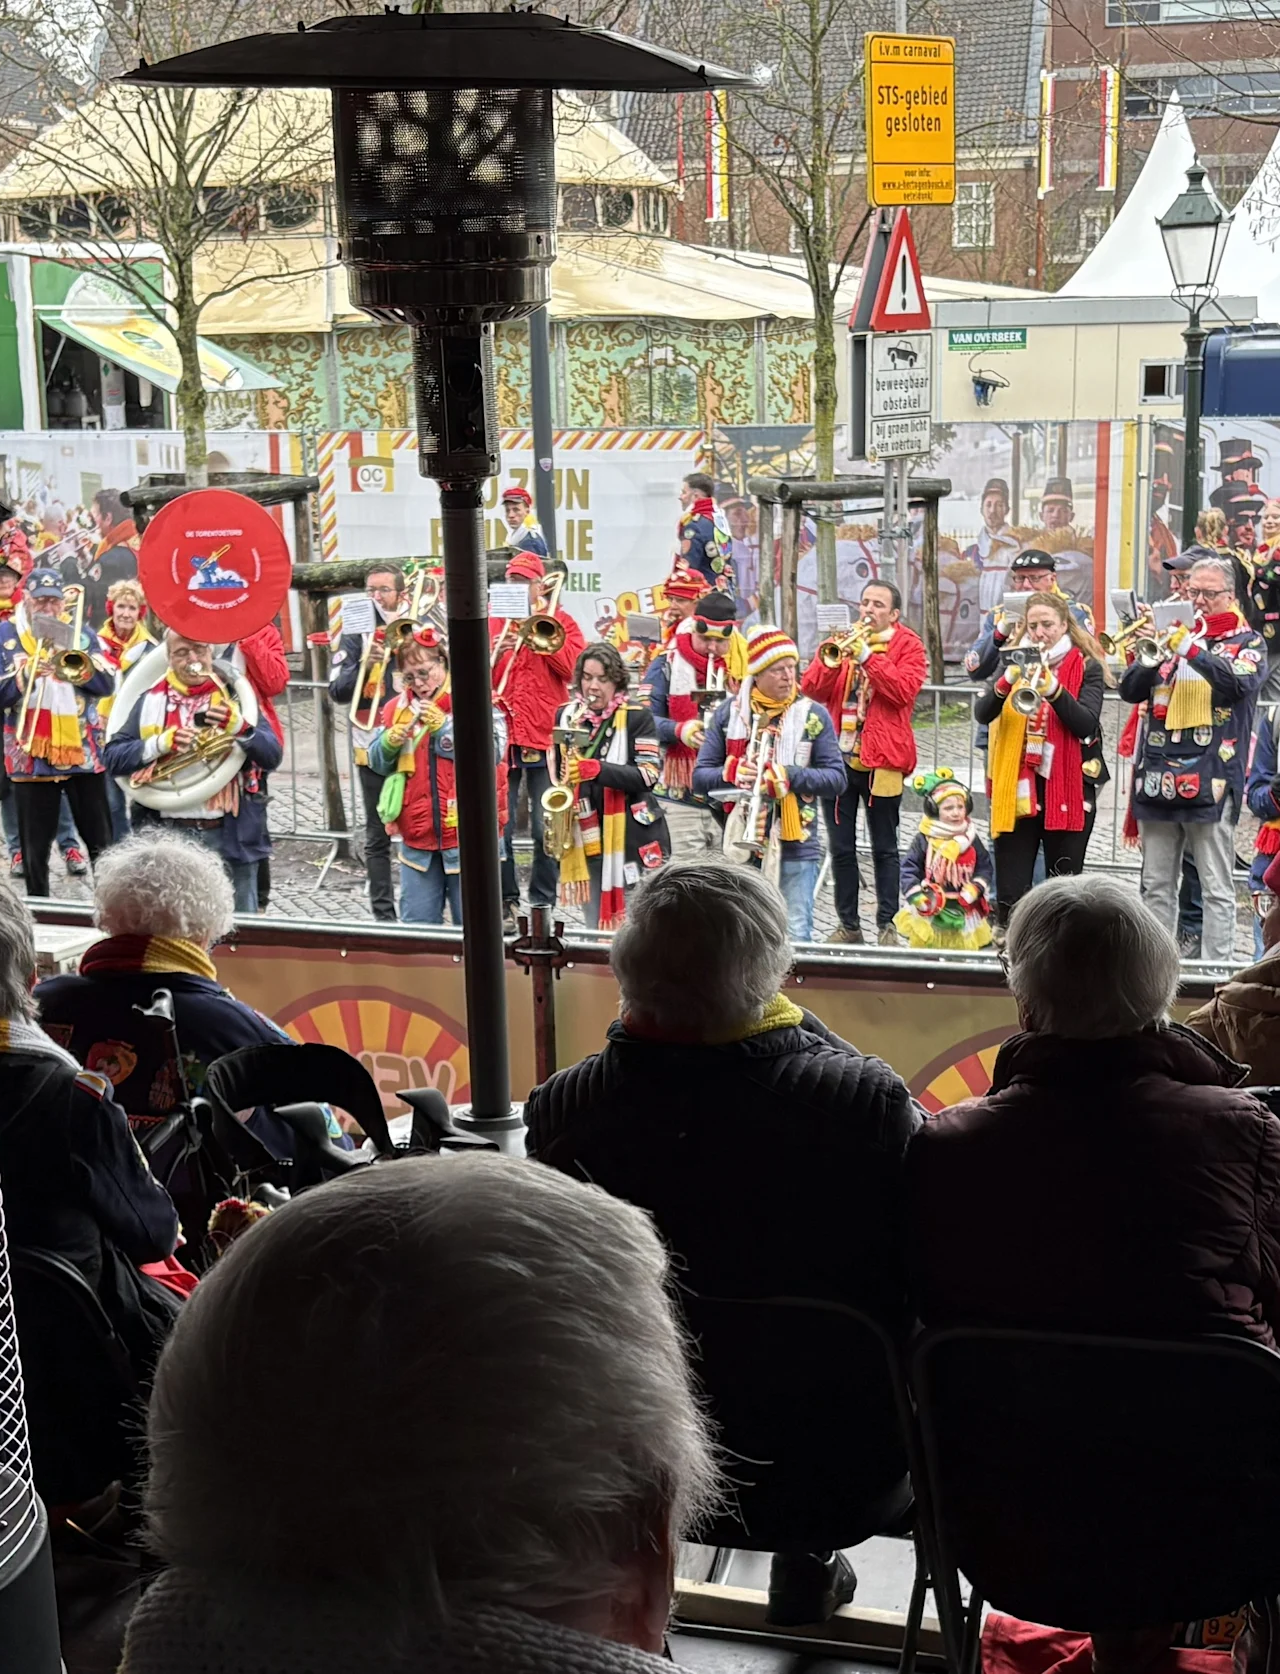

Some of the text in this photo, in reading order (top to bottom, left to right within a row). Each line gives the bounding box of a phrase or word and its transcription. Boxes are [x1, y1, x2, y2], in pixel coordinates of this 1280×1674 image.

[879, 42, 941, 58] i.v.m carnaval
[878, 85, 948, 110] STS-gebied
[886, 113, 941, 137] gesloten
[952, 331, 1022, 343] VAN OVERBEEK
[875, 377, 928, 393] beweegbaar
[883, 395, 921, 411] obstakel
[876, 419, 927, 439] bij groen licht
[360, 468, 384, 482] OC
